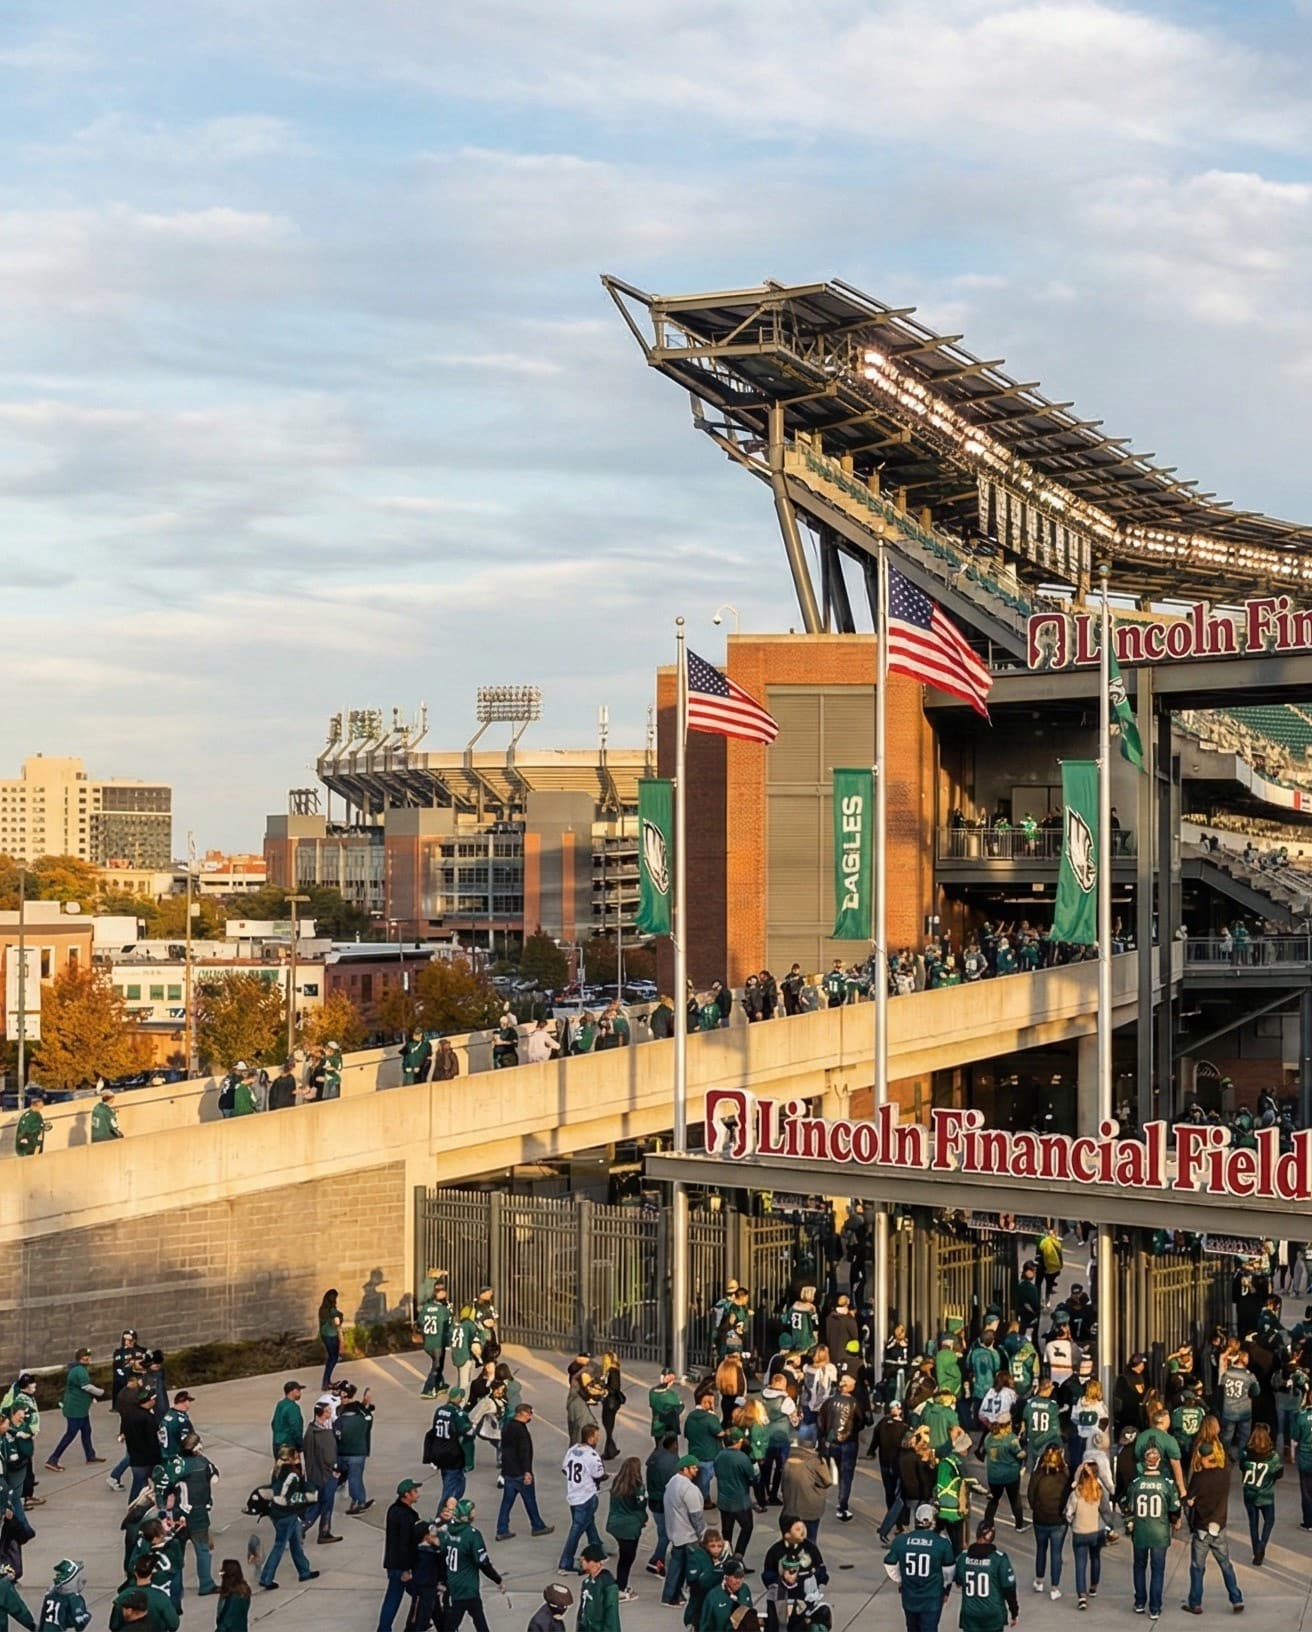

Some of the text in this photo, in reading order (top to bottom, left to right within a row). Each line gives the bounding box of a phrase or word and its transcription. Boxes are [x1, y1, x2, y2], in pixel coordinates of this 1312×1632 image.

[755, 1098, 926, 1169] Lincoln
[931, 1106, 1165, 1188] Financial
[1031, 1412, 1049, 1431] 18
[568, 1460, 583, 1484] 18
[1136, 1493, 1163, 1518] 60
[905, 1552, 930, 1577] 50
[965, 1570, 990, 1597] 50
